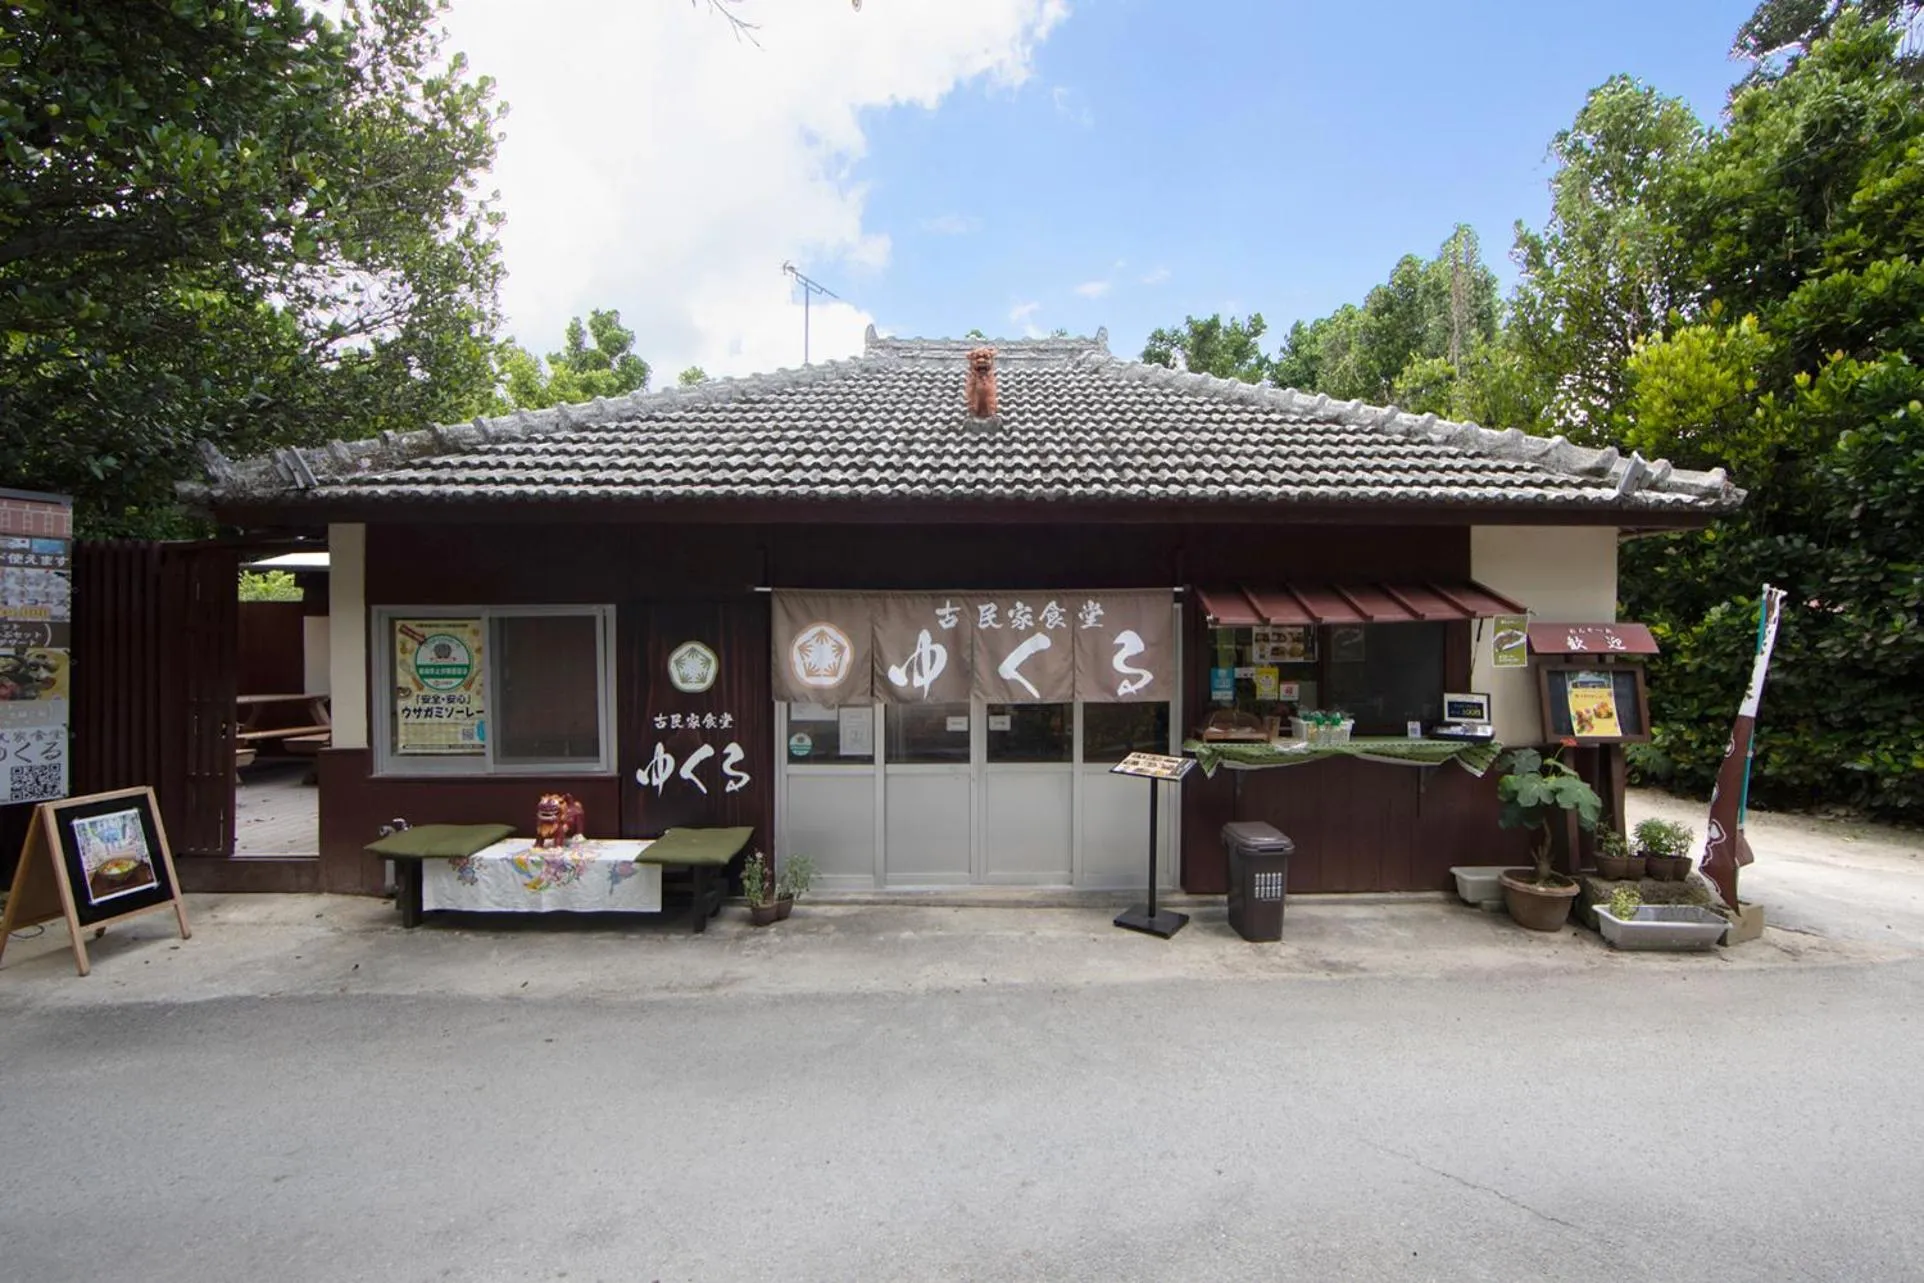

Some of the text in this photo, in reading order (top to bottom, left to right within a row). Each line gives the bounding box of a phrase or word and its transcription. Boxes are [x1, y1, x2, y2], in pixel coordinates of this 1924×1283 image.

[935, 600, 1104, 630] 古民家食堂
[888, 629, 1153, 699] ゆくる
[402, 706, 485, 719] ウサガミソーレー
[653, 712, 733, 729] 古民家食堂
[636, 742, 750, 798] ゆくる
